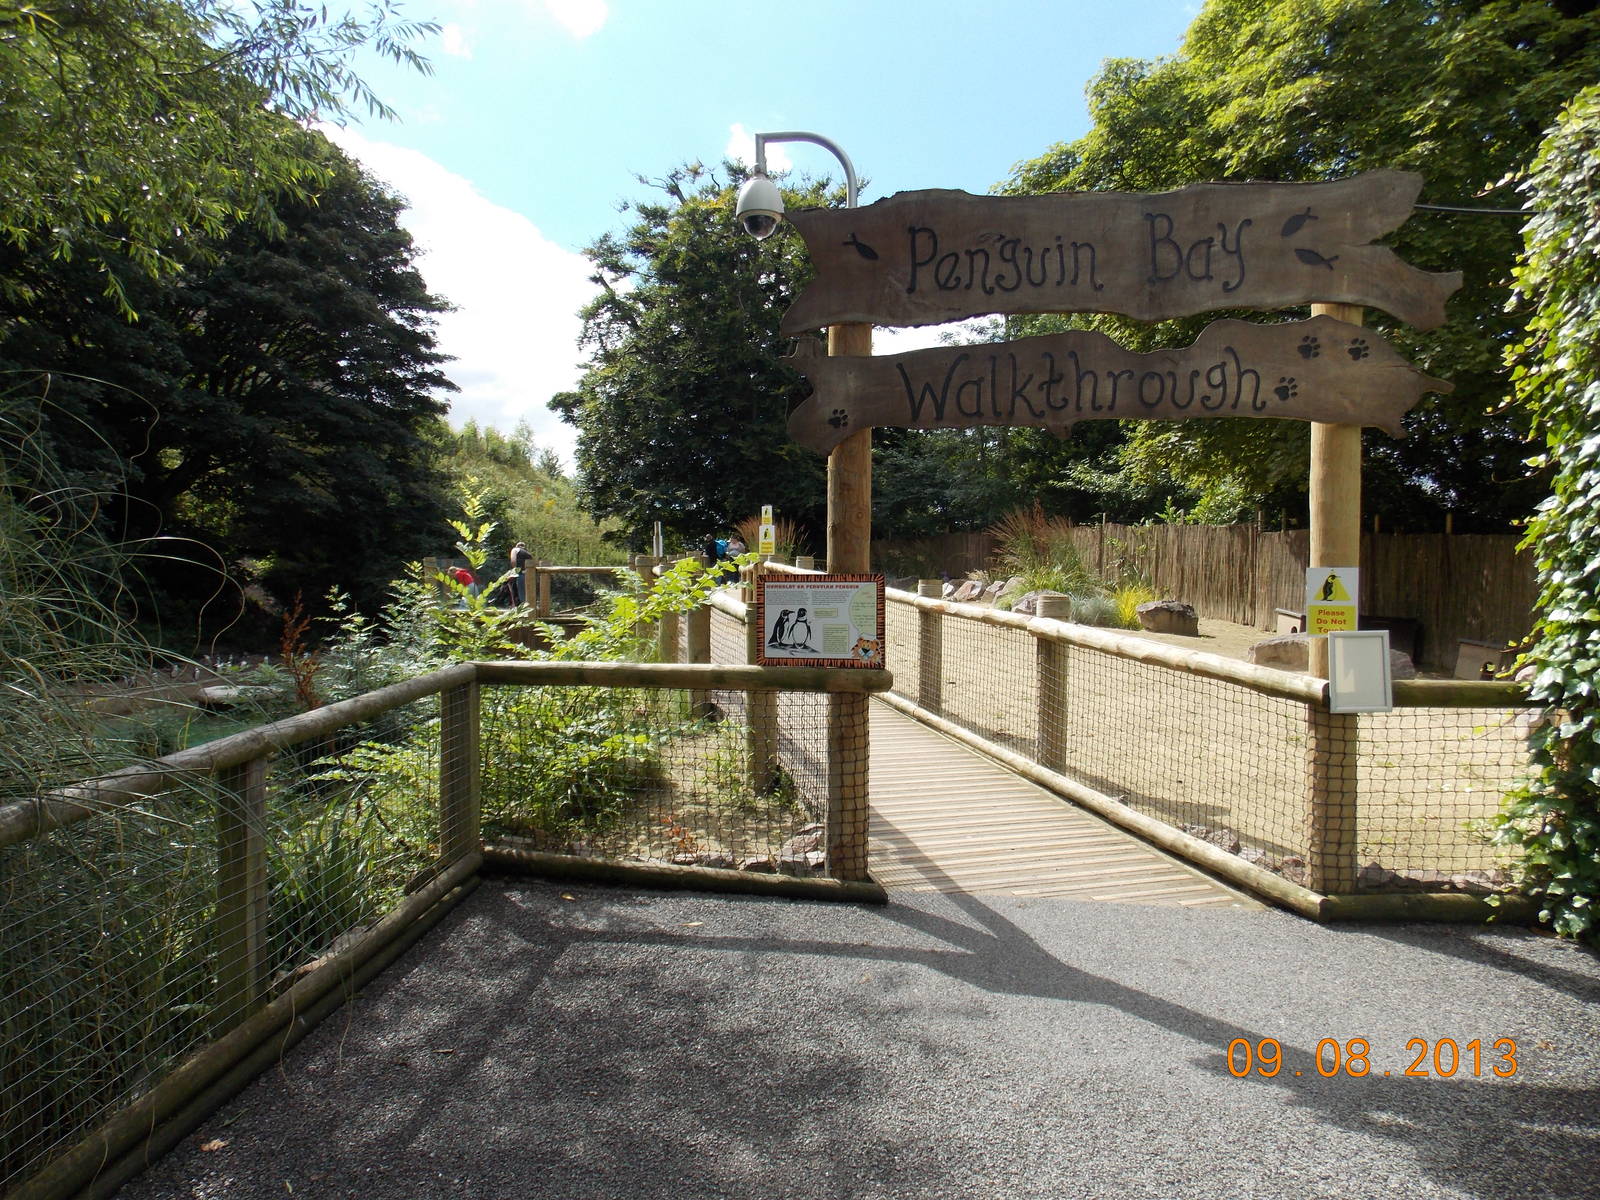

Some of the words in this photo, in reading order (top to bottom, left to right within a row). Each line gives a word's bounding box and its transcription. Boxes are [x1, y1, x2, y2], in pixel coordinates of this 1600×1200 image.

[906, 225, 1104, 295] Penguin
[1144, 212, 1252, 293] Bay
[895, 345, 1267, 422] Walkthrough
